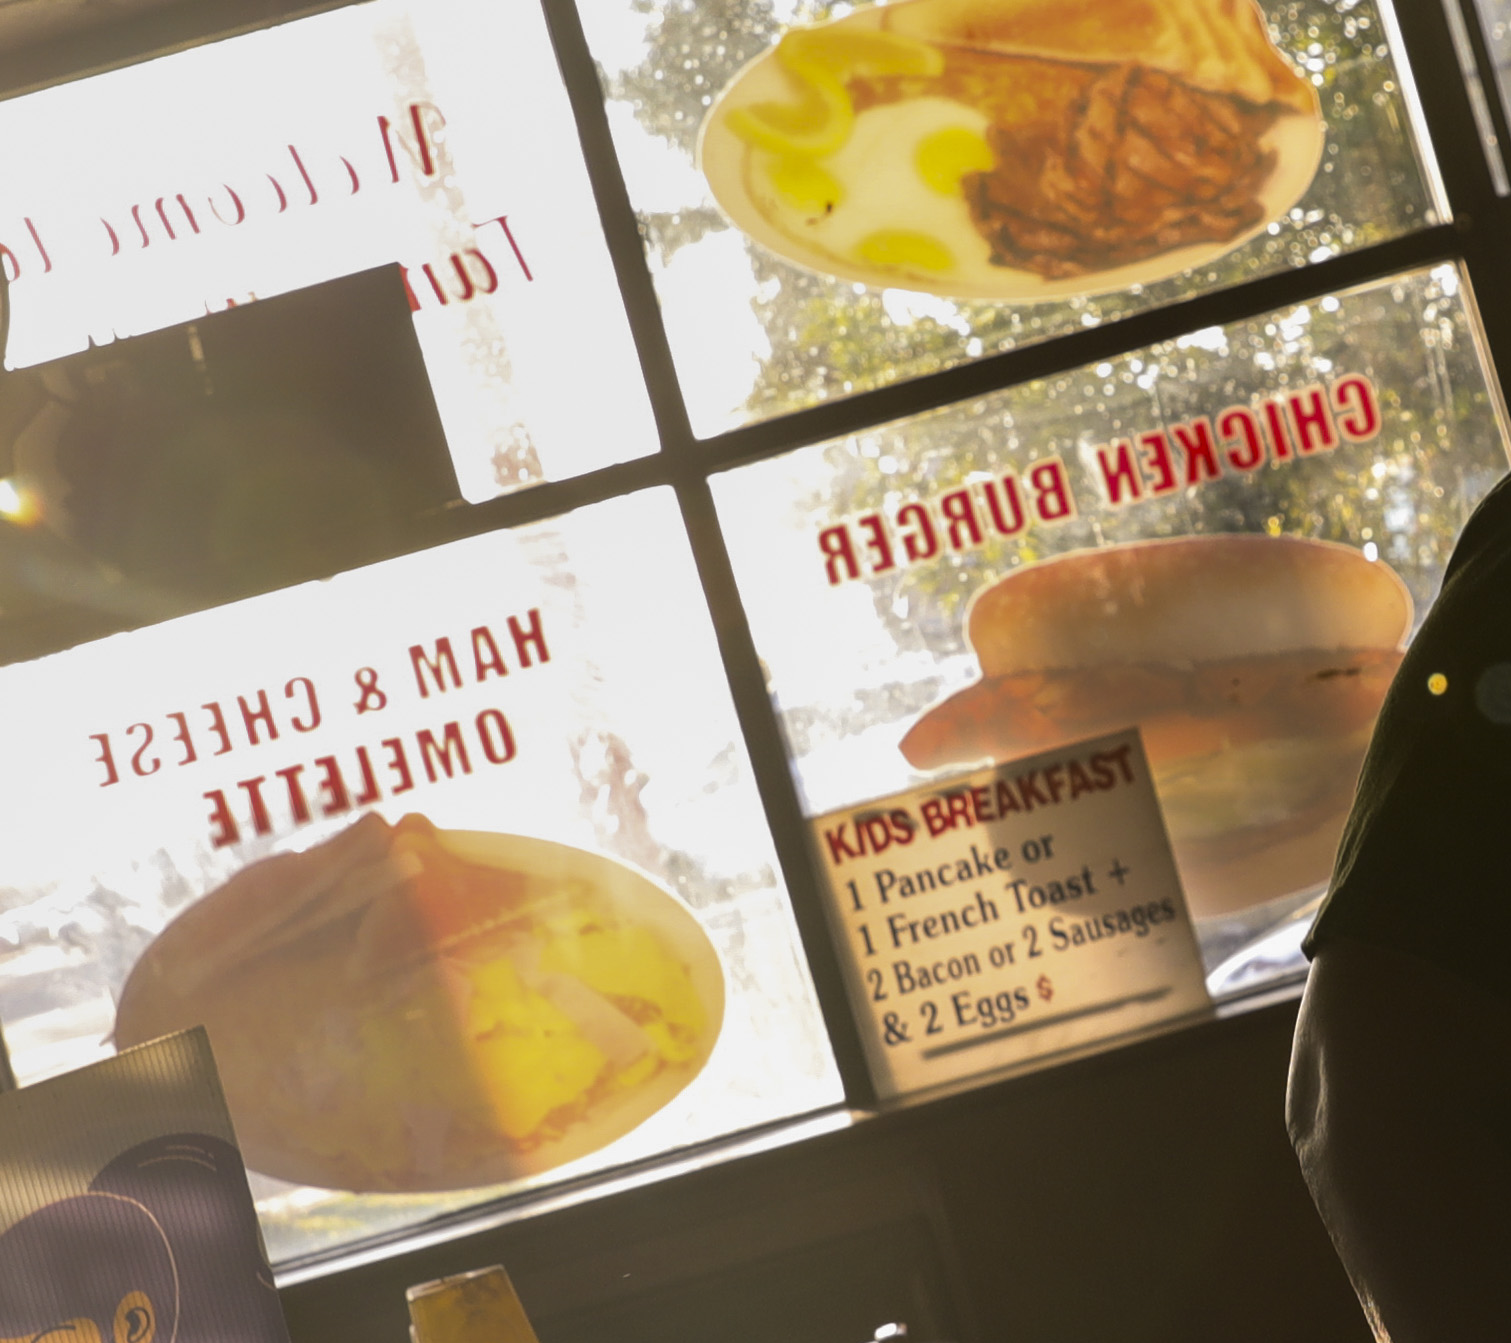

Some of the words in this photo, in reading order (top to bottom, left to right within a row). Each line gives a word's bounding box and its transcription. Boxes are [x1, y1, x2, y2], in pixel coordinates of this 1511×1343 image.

[824, 808, 916, 866] KIDS
[920, 745, 1137, 838] BREAKFAST
[846, 879, 865, 912] 1
[874, 844, 1012, 904] Pancake
[1021, 833, 1055, 863] or
[858, 923, 877, 957] 1
[886, 892, 1000, 948] French
[1005, 863, 1097, 914] Toast
[867, 968, 888, 1002] 2
[893, 949, 982, 995] Bacon
[989, 941, 1016, 968] or
[1023, 925, 1043, 959] 2
[1048, 896, 1177, 951] Sausages
[881, 1010, 912, 1048] &
[920, 1001, 943, 1036] 2
[951, 986, 1030, 1029] Eggs
[1036, 974, 1055, 1002] $
